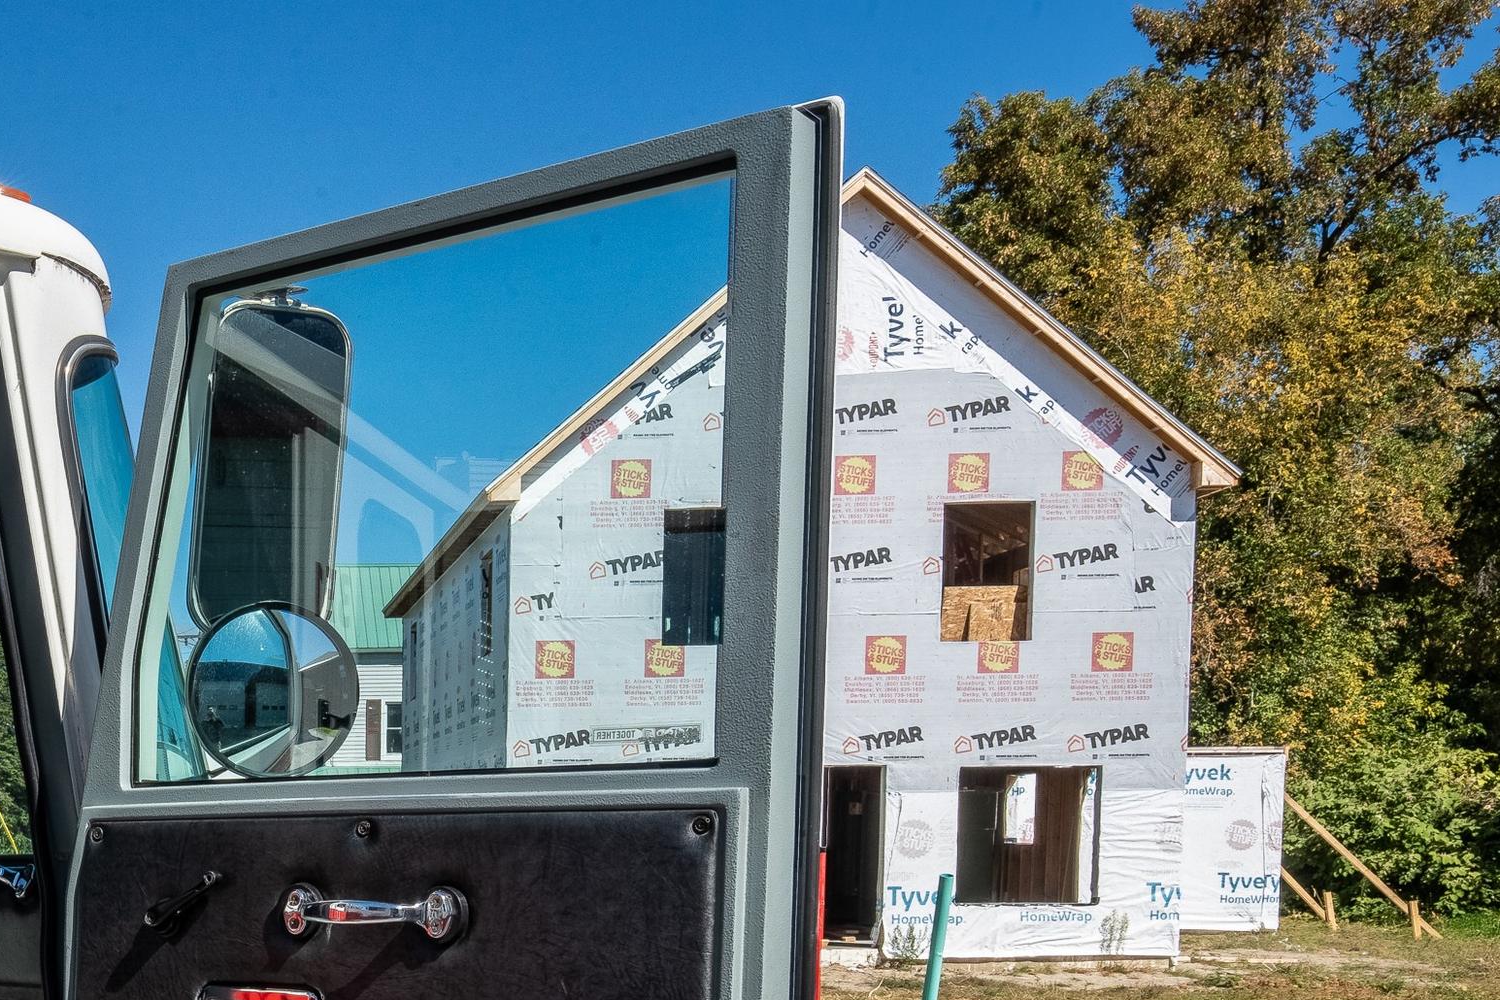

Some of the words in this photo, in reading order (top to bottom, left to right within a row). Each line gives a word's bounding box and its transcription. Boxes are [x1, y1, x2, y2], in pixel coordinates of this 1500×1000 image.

[860, 219, 896, 258] Home
[913, 315, 925, 355] Home
[835, 398, 898, 425] TYPAR
[945, 395, 1011, 422] TYPAR
[615, 467, 649, 481] STICKS
[839, 464, 875, 478] STICKS
[953, 462, 987, 476] STICKS
[1124, 442, 1172, 485] Tyv
[1151, 459, 1188, 496] Home
[830, 546, 892, 572] TYPAR
[1053, 543, 1119, 569] TYPAR
[540, 649, 573, 662] STICKS
[649, 648, 683, 661] STICKS
[870, 643, 904, 658] STICKS
[983, 643, 1017, 656] STICKS
[1097, 641, 1132, 655] STICKS
[529, 729, 590, 754] TYPAR
[858, 726, 924, 750] TYPAR
[970, 724, 1036, 750] TYPAR
[1084, 723, 1150, 749] TYPAR
[887, 886, 953, 912] Tyve
[1020, 911, 1092, 925] HomeWrap
